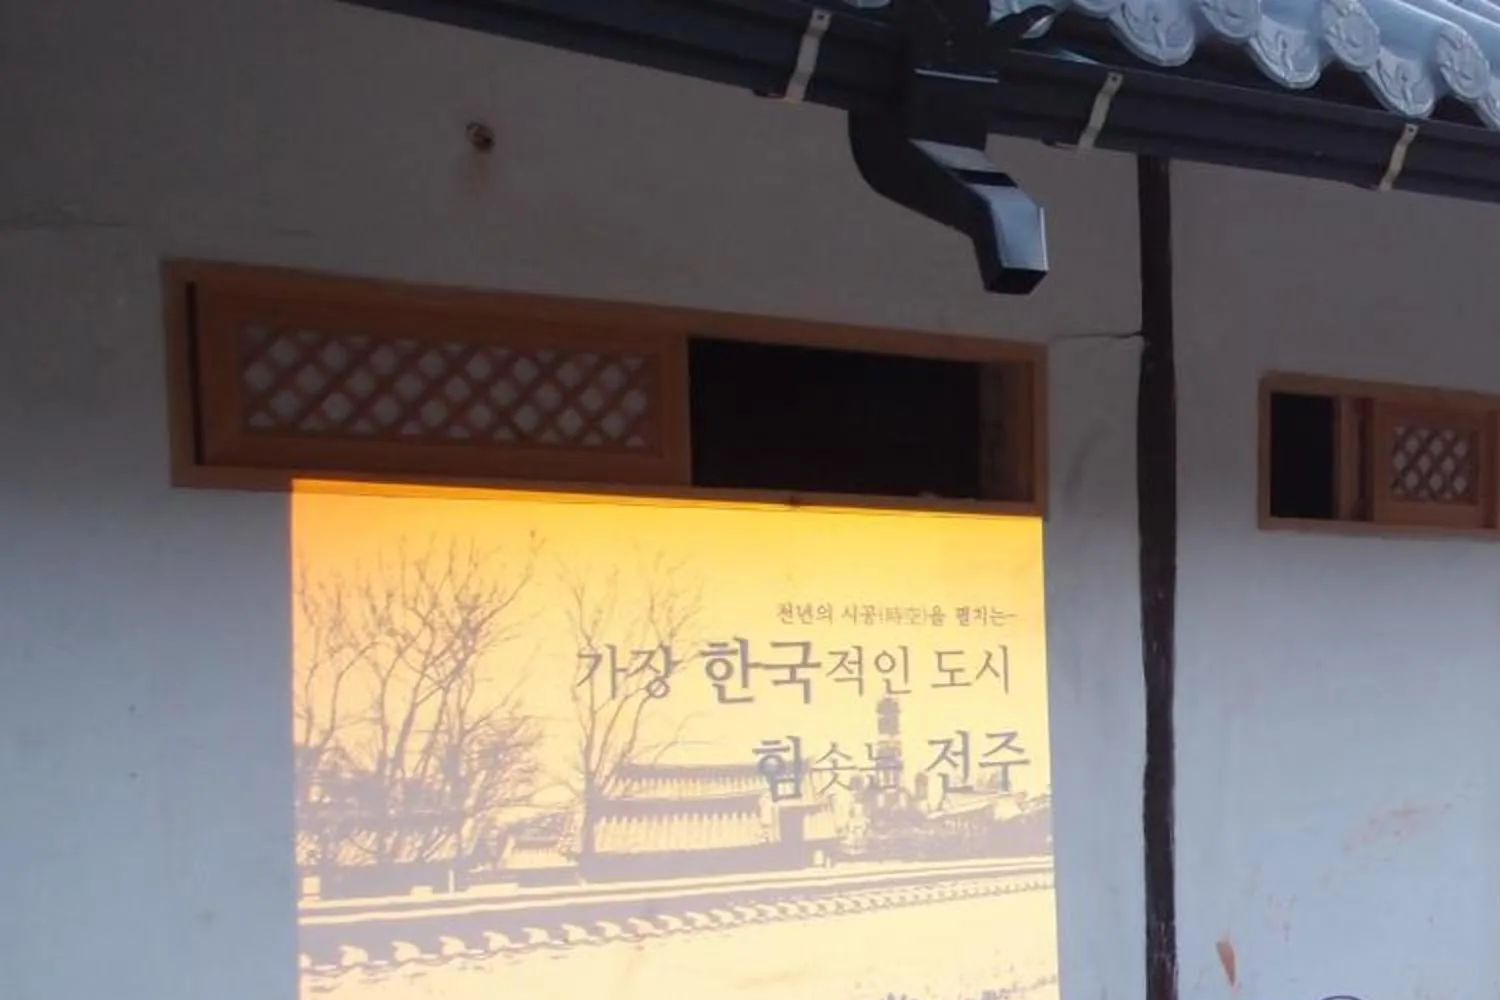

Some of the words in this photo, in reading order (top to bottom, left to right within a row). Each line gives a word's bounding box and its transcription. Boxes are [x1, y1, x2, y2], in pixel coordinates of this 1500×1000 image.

[576, 642, 681, 700] 가장
[701, 637, 912, 704] 한국적인
[931, 644, 1010, 694] 도시
[752, 735, 898, 801] 힘솟는
[927, 729, 1031, 797] 전주
